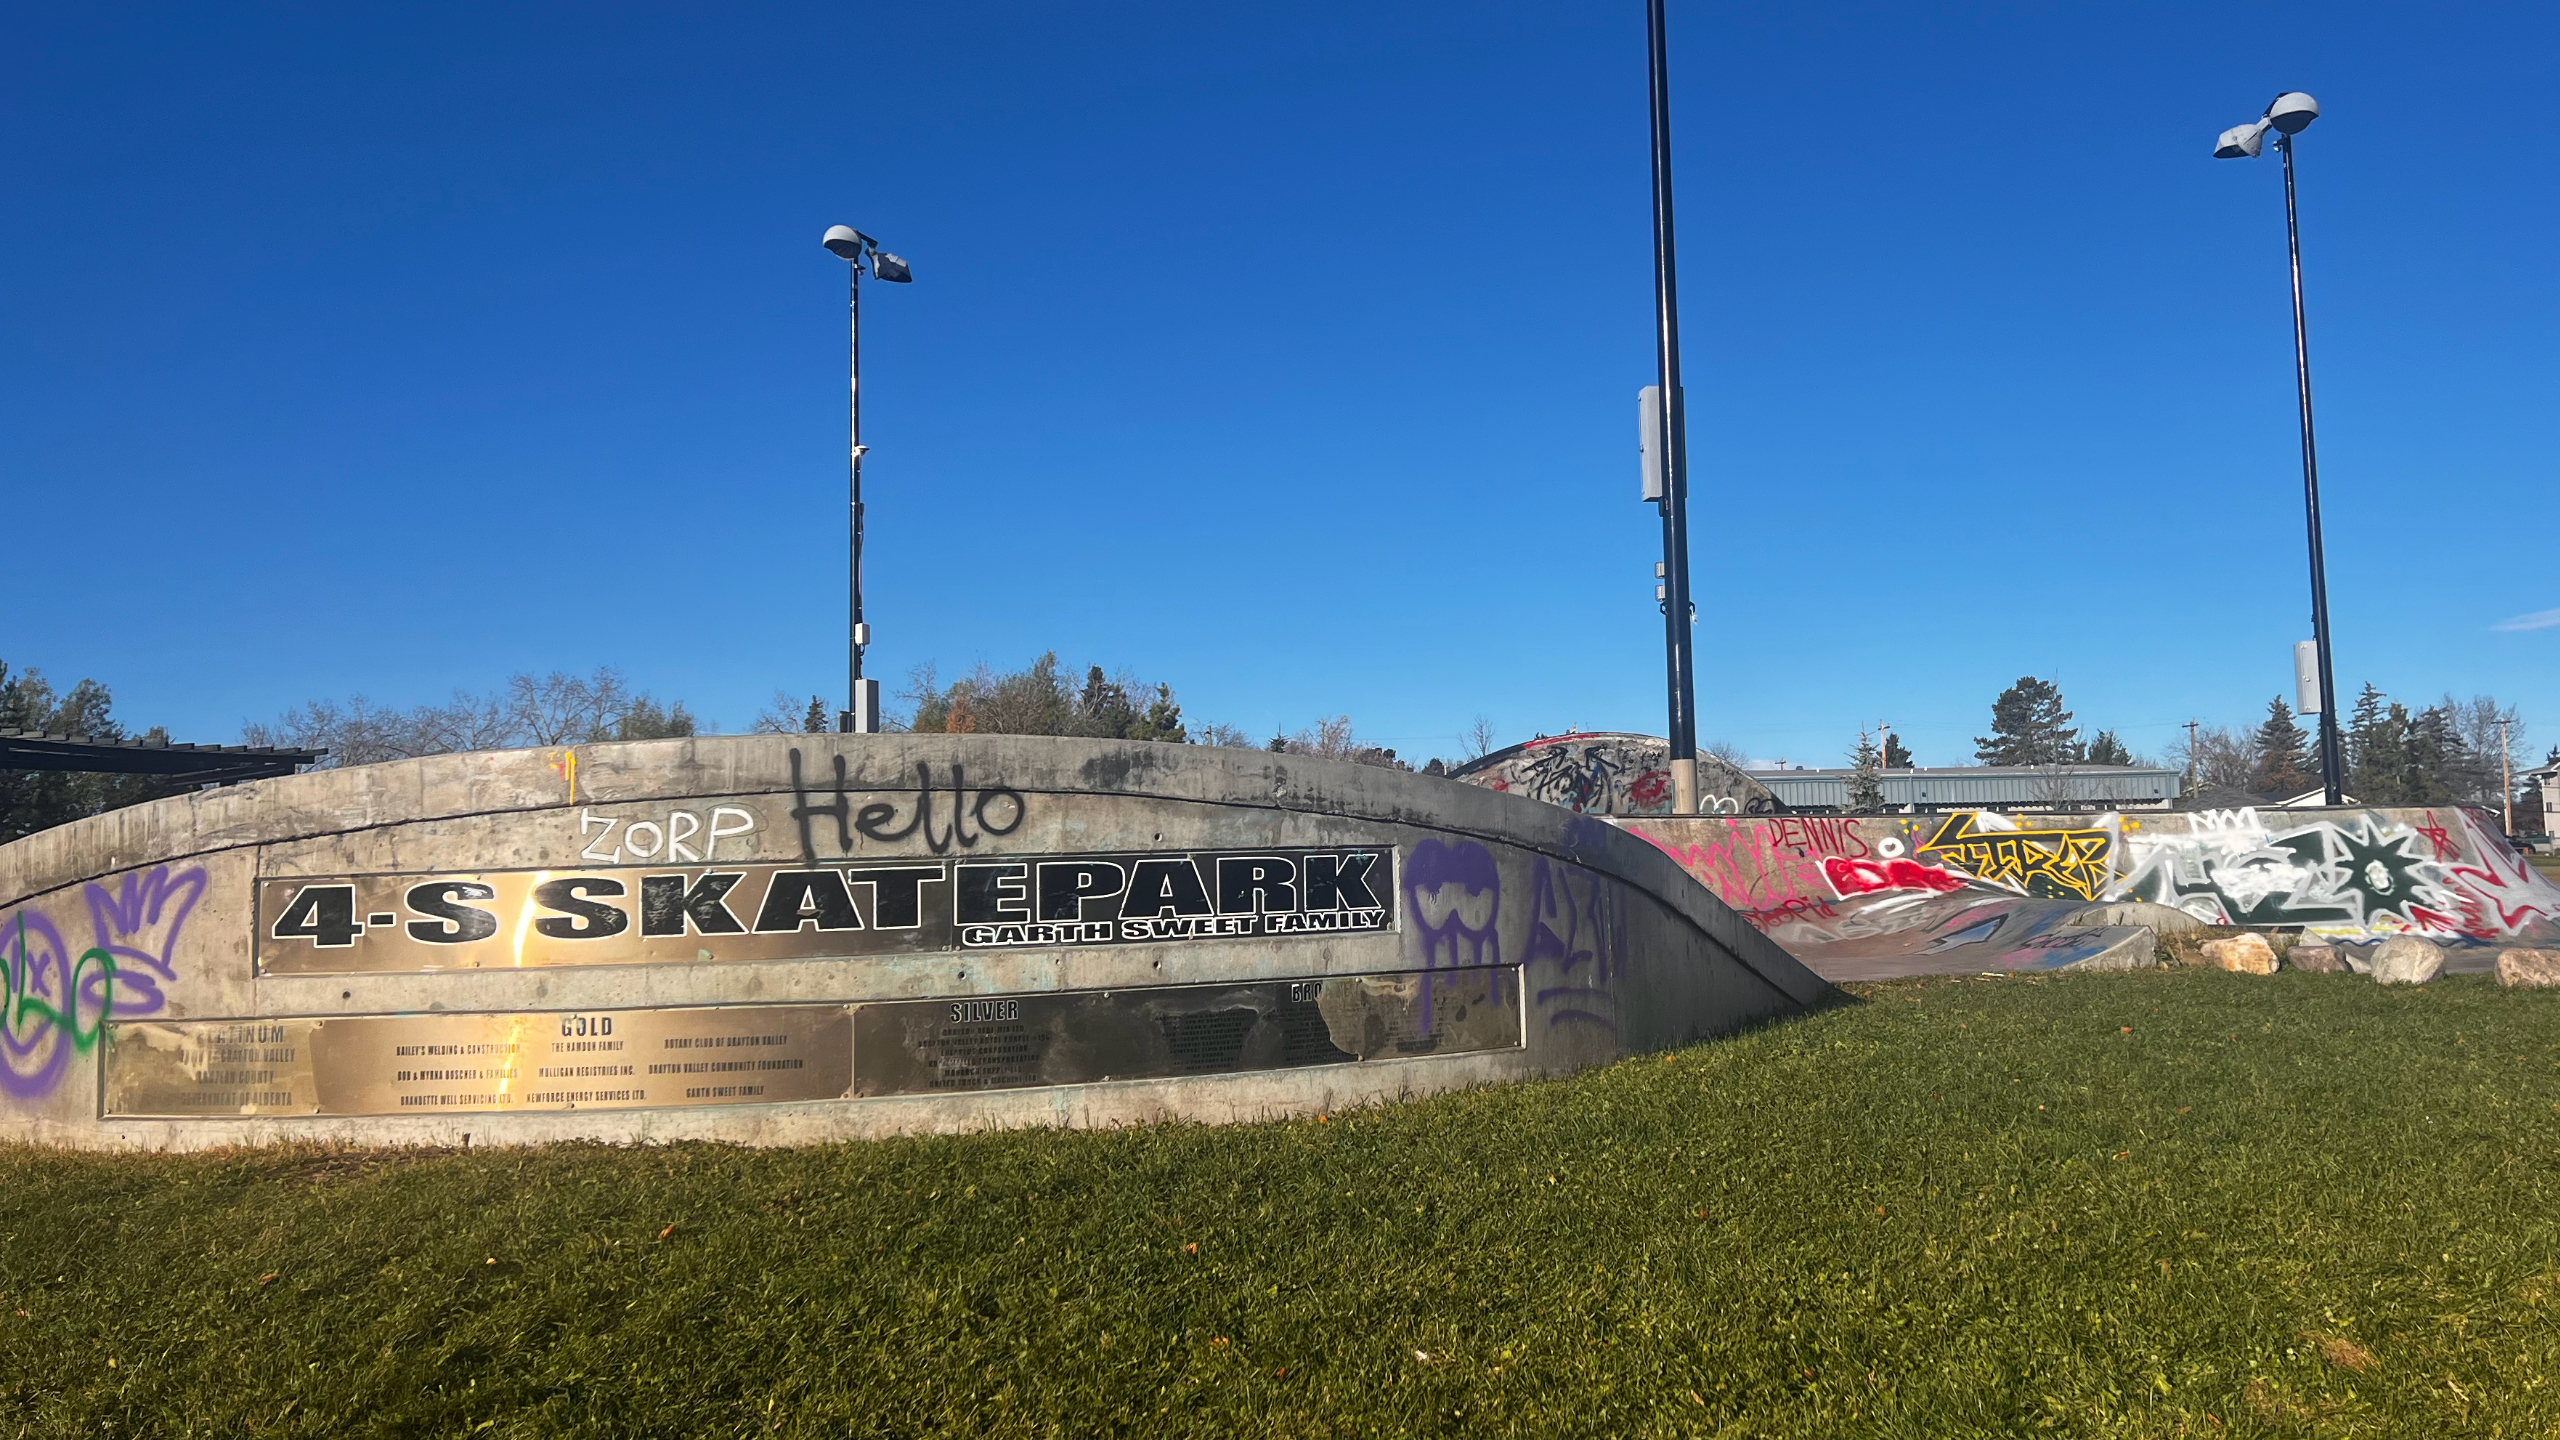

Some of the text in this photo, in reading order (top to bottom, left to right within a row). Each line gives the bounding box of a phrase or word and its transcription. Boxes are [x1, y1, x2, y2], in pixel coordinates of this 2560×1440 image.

[789, 746, 1026, 870] Hello
[579, 805, 756, 864] ZORP
[271, 853, 1384, 948] 4-S SKATEPARK
[961, 908, 1385, 947] GARTH SWEET FAMILY
[949, 999, 1020, 1024] SILVER
[561, 1016, 613, 1037] GOLD
[428, 1044, 458, 1056] WELDING
[460, 1046, 465, 1055] &
[467, 1043, 521, 1055] CONSTRUCTION
[551, 1042, 564, 1053] THE
[598, 1040, 625, 1052] FAMILY
[664, 1034, 788, 1050] ROTARY CLUB OF DRAYTON VALLEY
[263, 1048, 296, 1063] VALLEY
[538, 1064, 636, 1078] MULLIGAN REGISTRIES INC.
[648, 1058, 804, 1074] DRAYTON VALLEY COMMUNITY FOUNDATION
[238, 1070, 274, 1084] COUNTY
[412, 1071, 418, 1081] &
[420, 1070, 444, 1081] MYRNA
[479, 1070, 484, 1080] &
[486, 1067, 519, 1080] FAMILIES
[252, 1091, 292, 1106] ALBERTA
[526, 1088, 648, 1104] NEWFORCE ENERGY SERVICES LTD.
[686, 1085, 764, 1098] GARTH SWEET FAMILY
[440, 1094, 458, 1106] WELL
[459, 1094, 496, 1105] SERVICING
